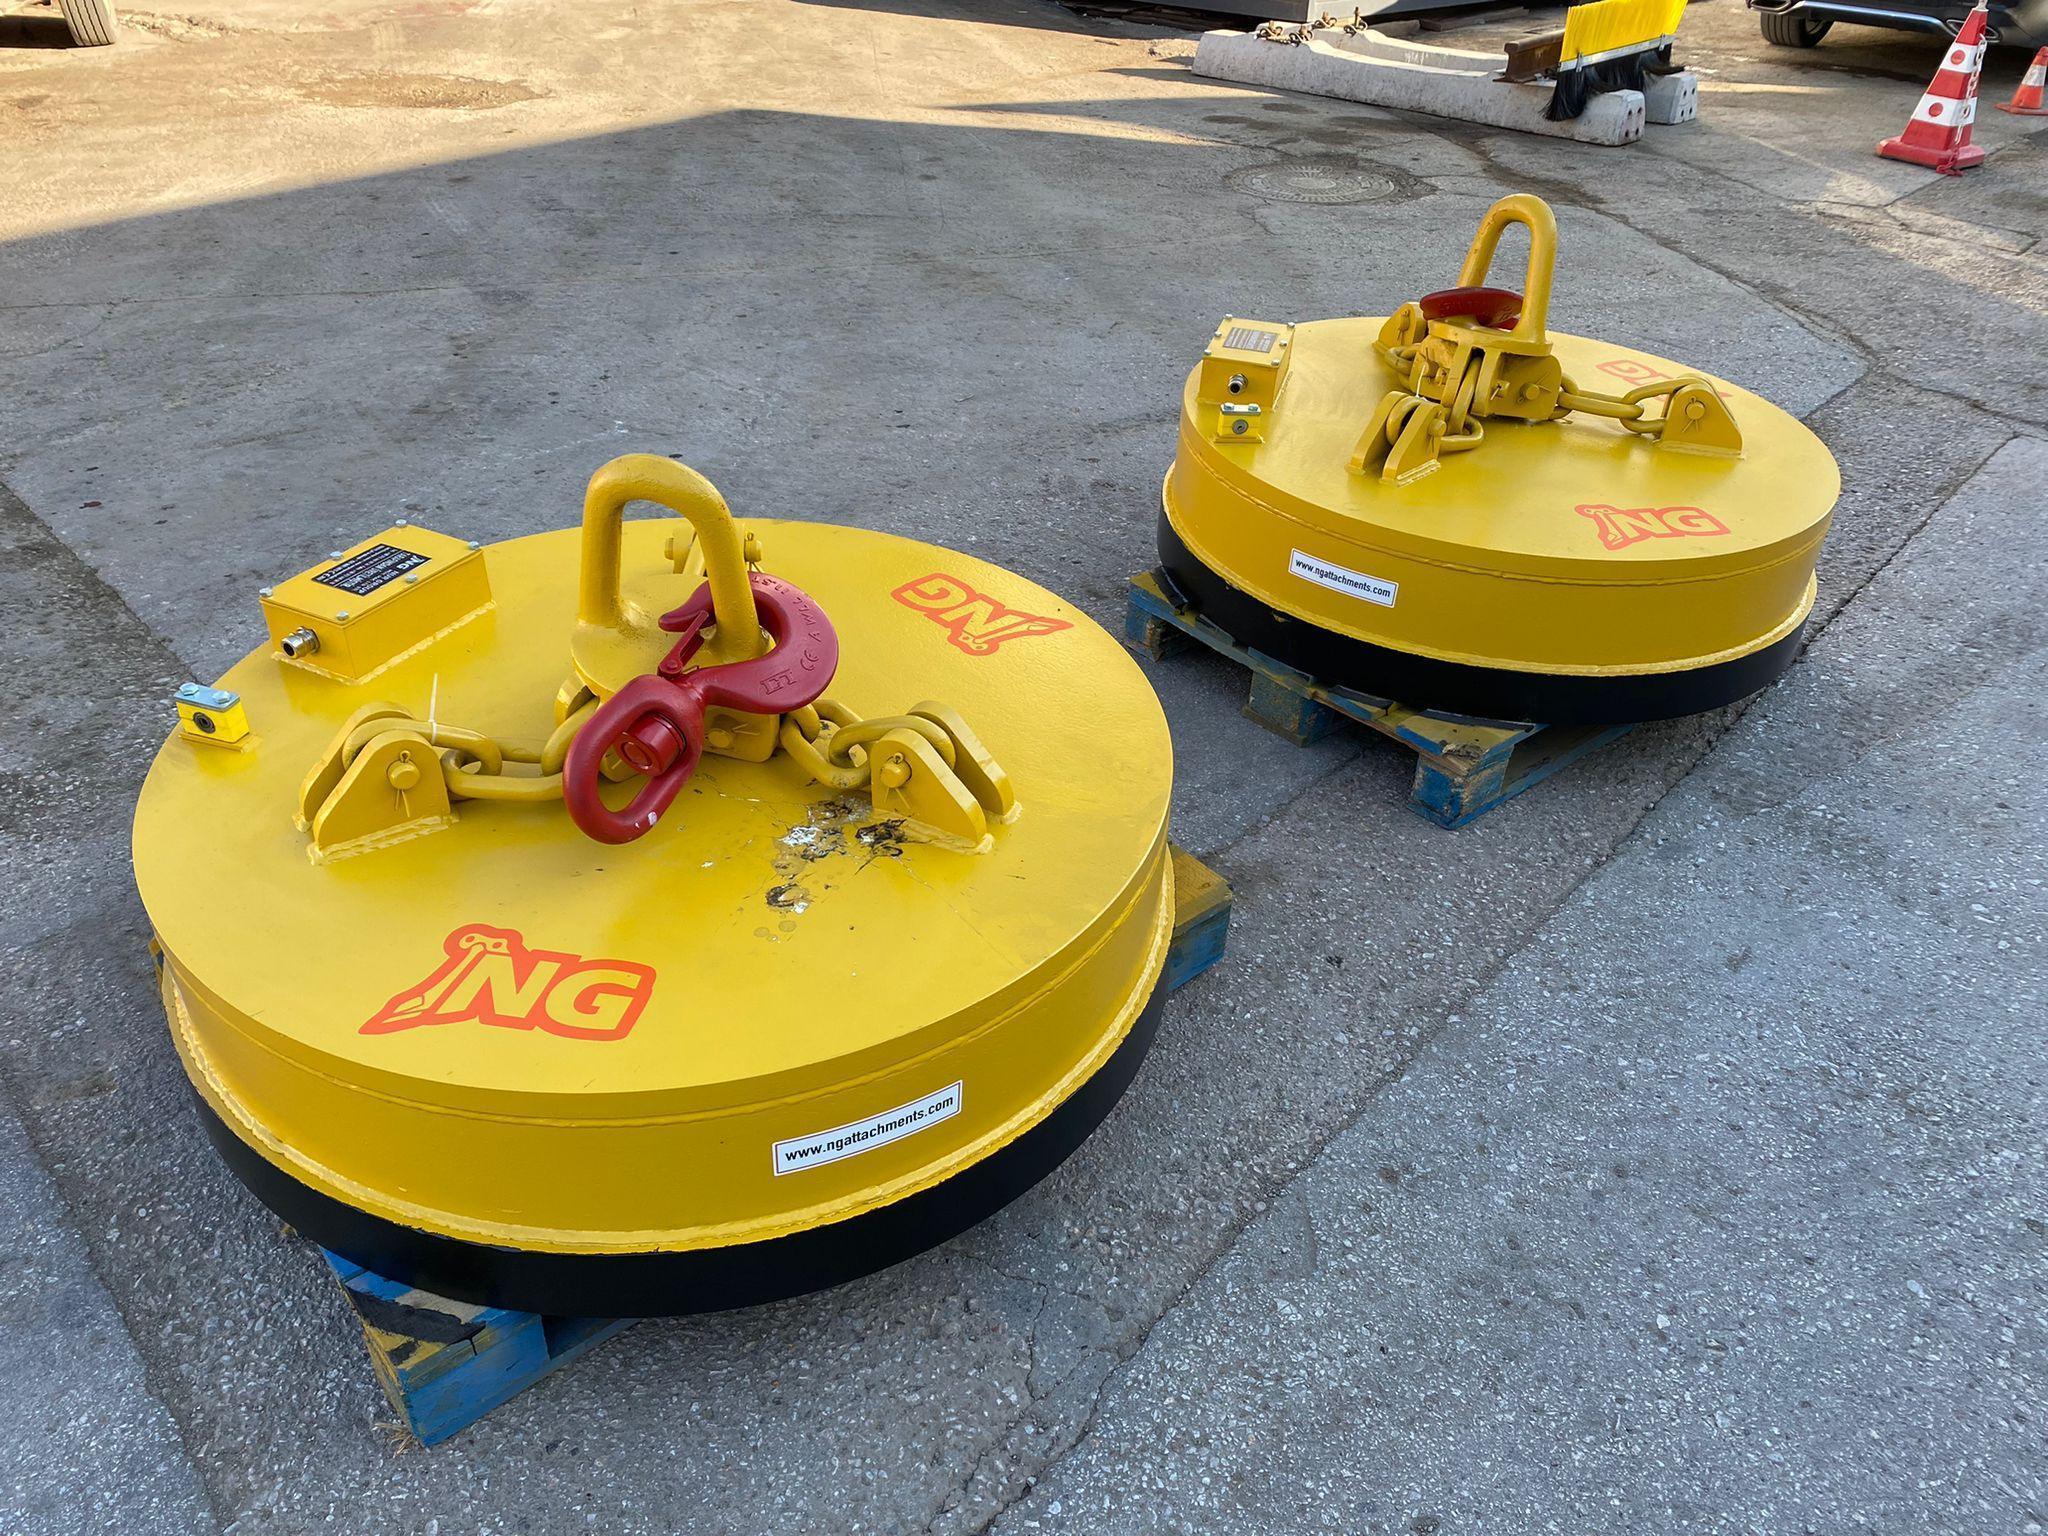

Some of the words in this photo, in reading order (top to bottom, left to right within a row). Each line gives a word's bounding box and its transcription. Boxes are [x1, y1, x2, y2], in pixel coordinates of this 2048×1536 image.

[1598, 506, 1730, 542] NG
[894, 574, 1036, 646] NG
[1295, 559, 1391, 598] www.ngattachments.com
[424, 945, 653, 1037] NG
[785, 1096, 954, 1162] www.ngattachments.com
